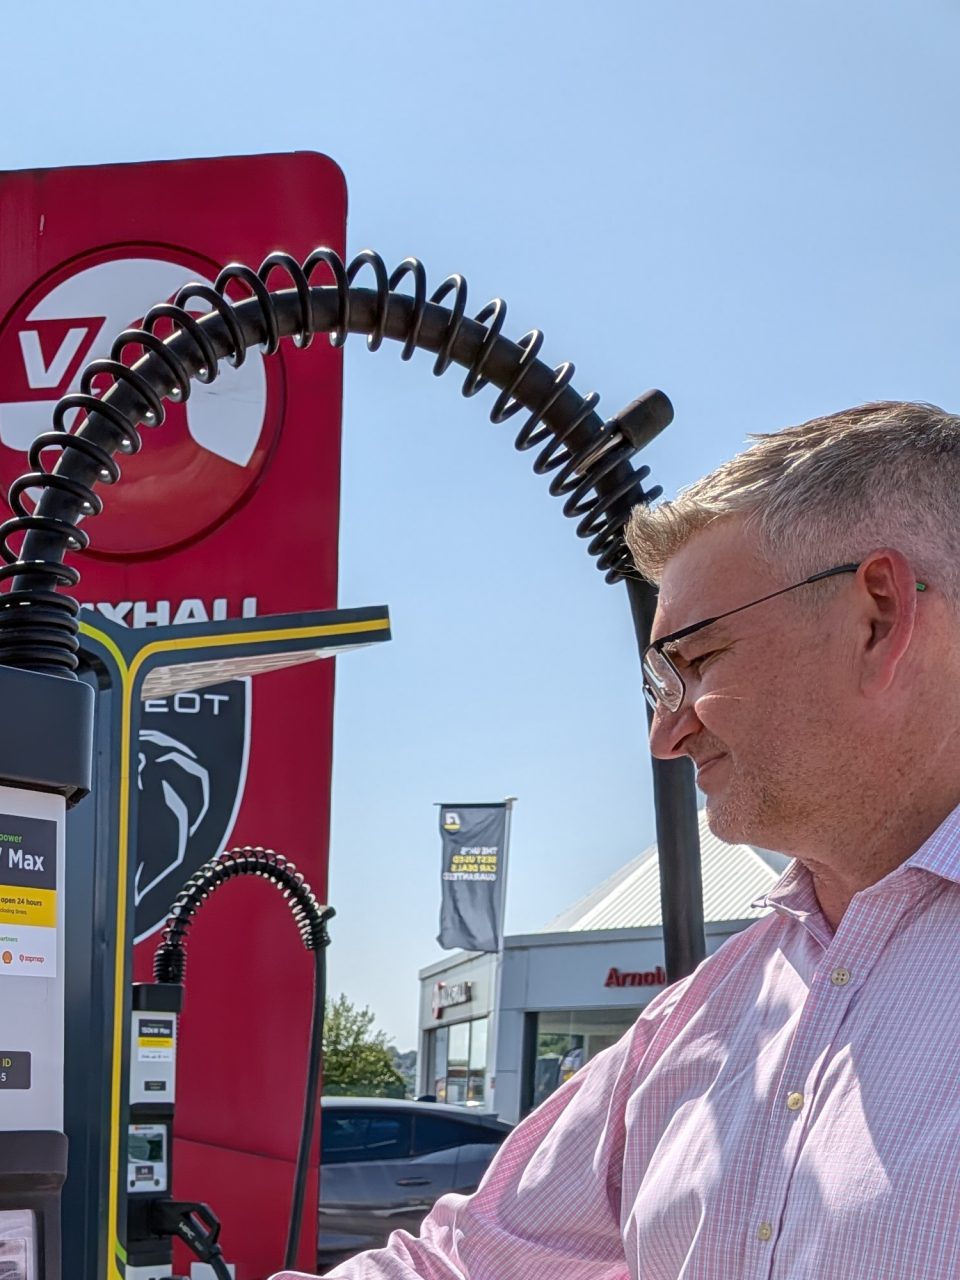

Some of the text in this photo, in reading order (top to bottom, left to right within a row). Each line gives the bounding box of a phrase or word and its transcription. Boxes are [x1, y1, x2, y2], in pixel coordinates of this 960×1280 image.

[144, 693, 229, 715] EOT
[8, 848, 45, 872] Max
[26, 898, 42, 906] hours
[2, 1058, 12, 1067] ID
